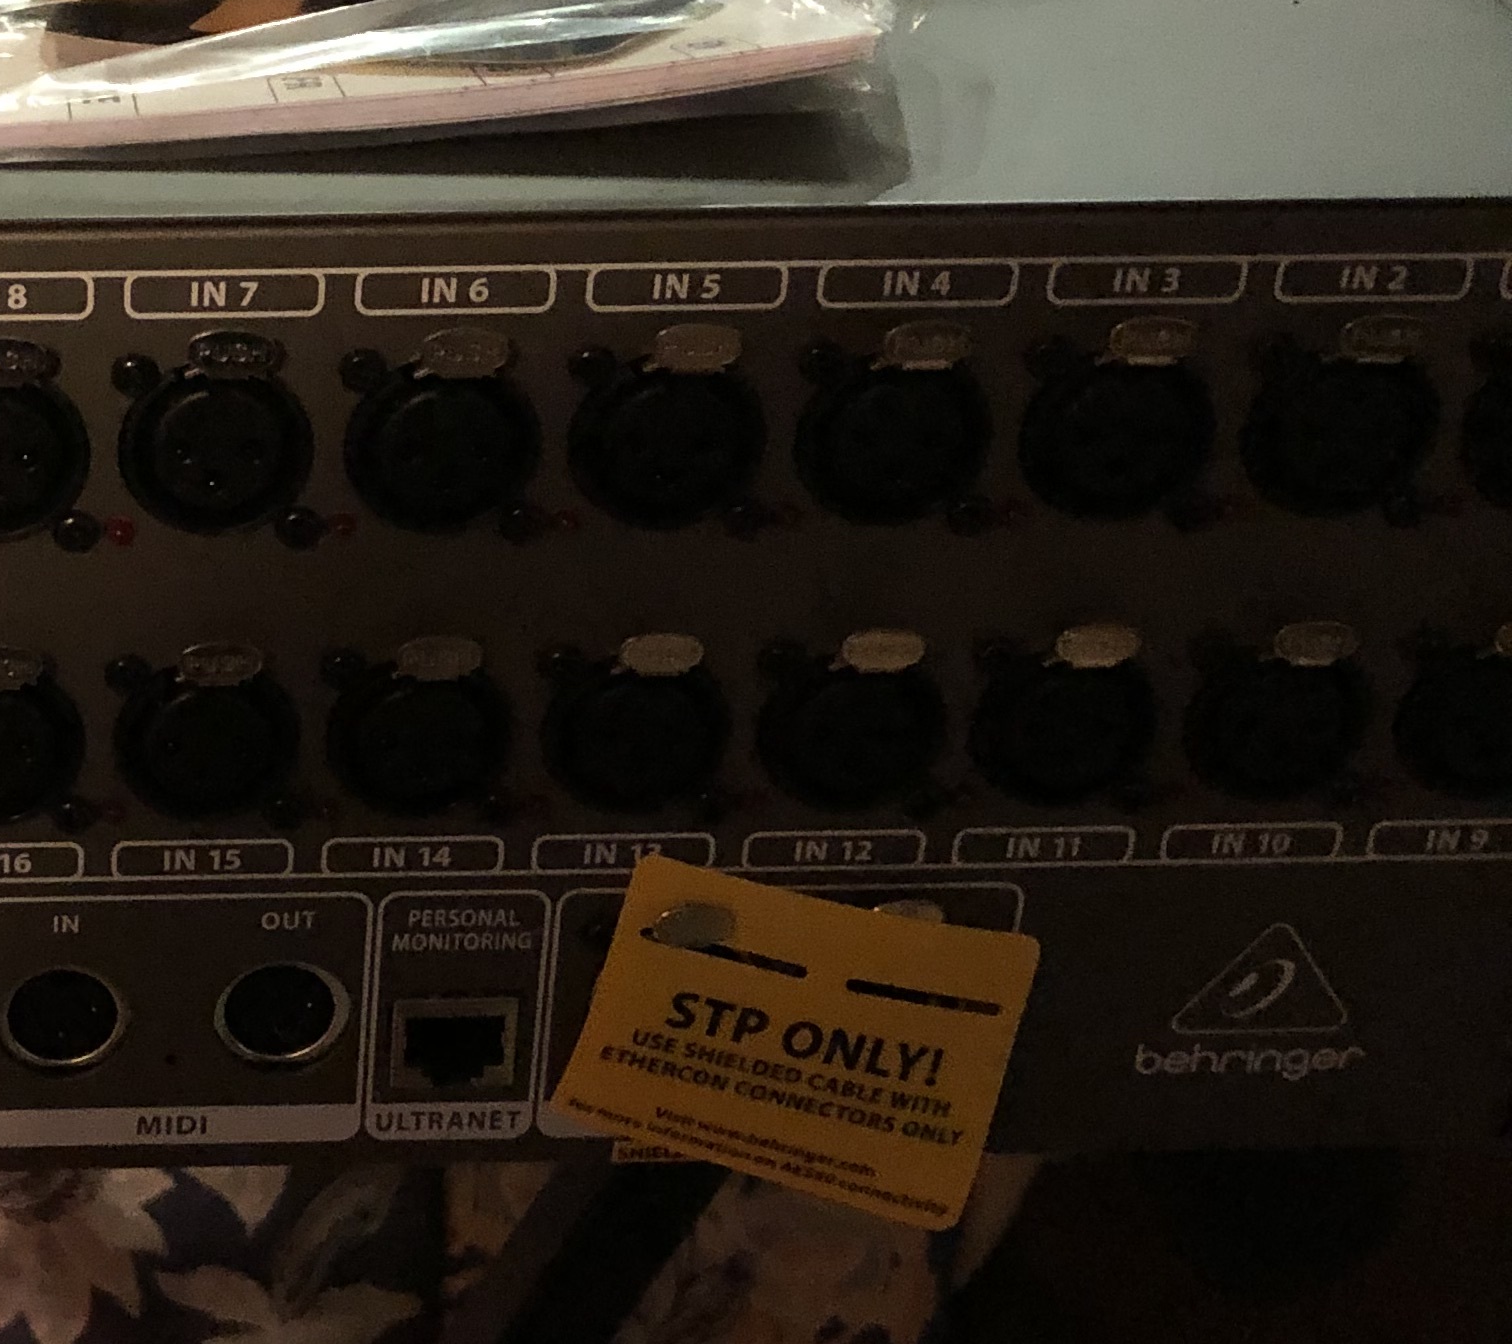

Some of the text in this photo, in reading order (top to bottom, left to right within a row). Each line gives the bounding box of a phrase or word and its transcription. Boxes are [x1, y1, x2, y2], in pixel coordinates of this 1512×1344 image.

[653, 273, 721, 300] IN 5
[883, 270, 951, 296] IN 4
[1113, 267, 1181, 293] IN 3
[1340, 265, 1408, 291] IN 2
[7, 283, 27, 310] 8
[190, 281, 259, 307] IN 7
[421, 277, 489, 303] IN 6
[794, 840, 873, 862] IN 12
[1006, 836, 1081, 859] IN 11
[1211, 832, 1292, 855] IN 10
[1426, 828, 1489, 851] IN 9
[0, 853, 32, 874] 16
[163, 849, 241, 871] IN 15
[372, 846, 451, 868] IN 14
[583, 843, 617, 865] IN
[53, 915, 80, 933] IN
[261, 910, 315, 931] OUT
[408, 908, 520, 928] PERSONAL
[391, 932, 532, 951] MONITORING
[665, 991, 944, 1086] STP ONLY!
[631, 1028, 952, 1118] USE SHIELDED CABLE WITH
[1134, 1043, 1365, 1082] behringer
[599, 1045, 965, 1146] ETHERCON CONNECTORS ONLY
[136, 1115, 208, 1136] MIDI
[374, 1108, 523, 1134] ULTRANET
[655, 1106, 696, 1127] Visit
[617, 1145, 689, 1161] SHIEL
